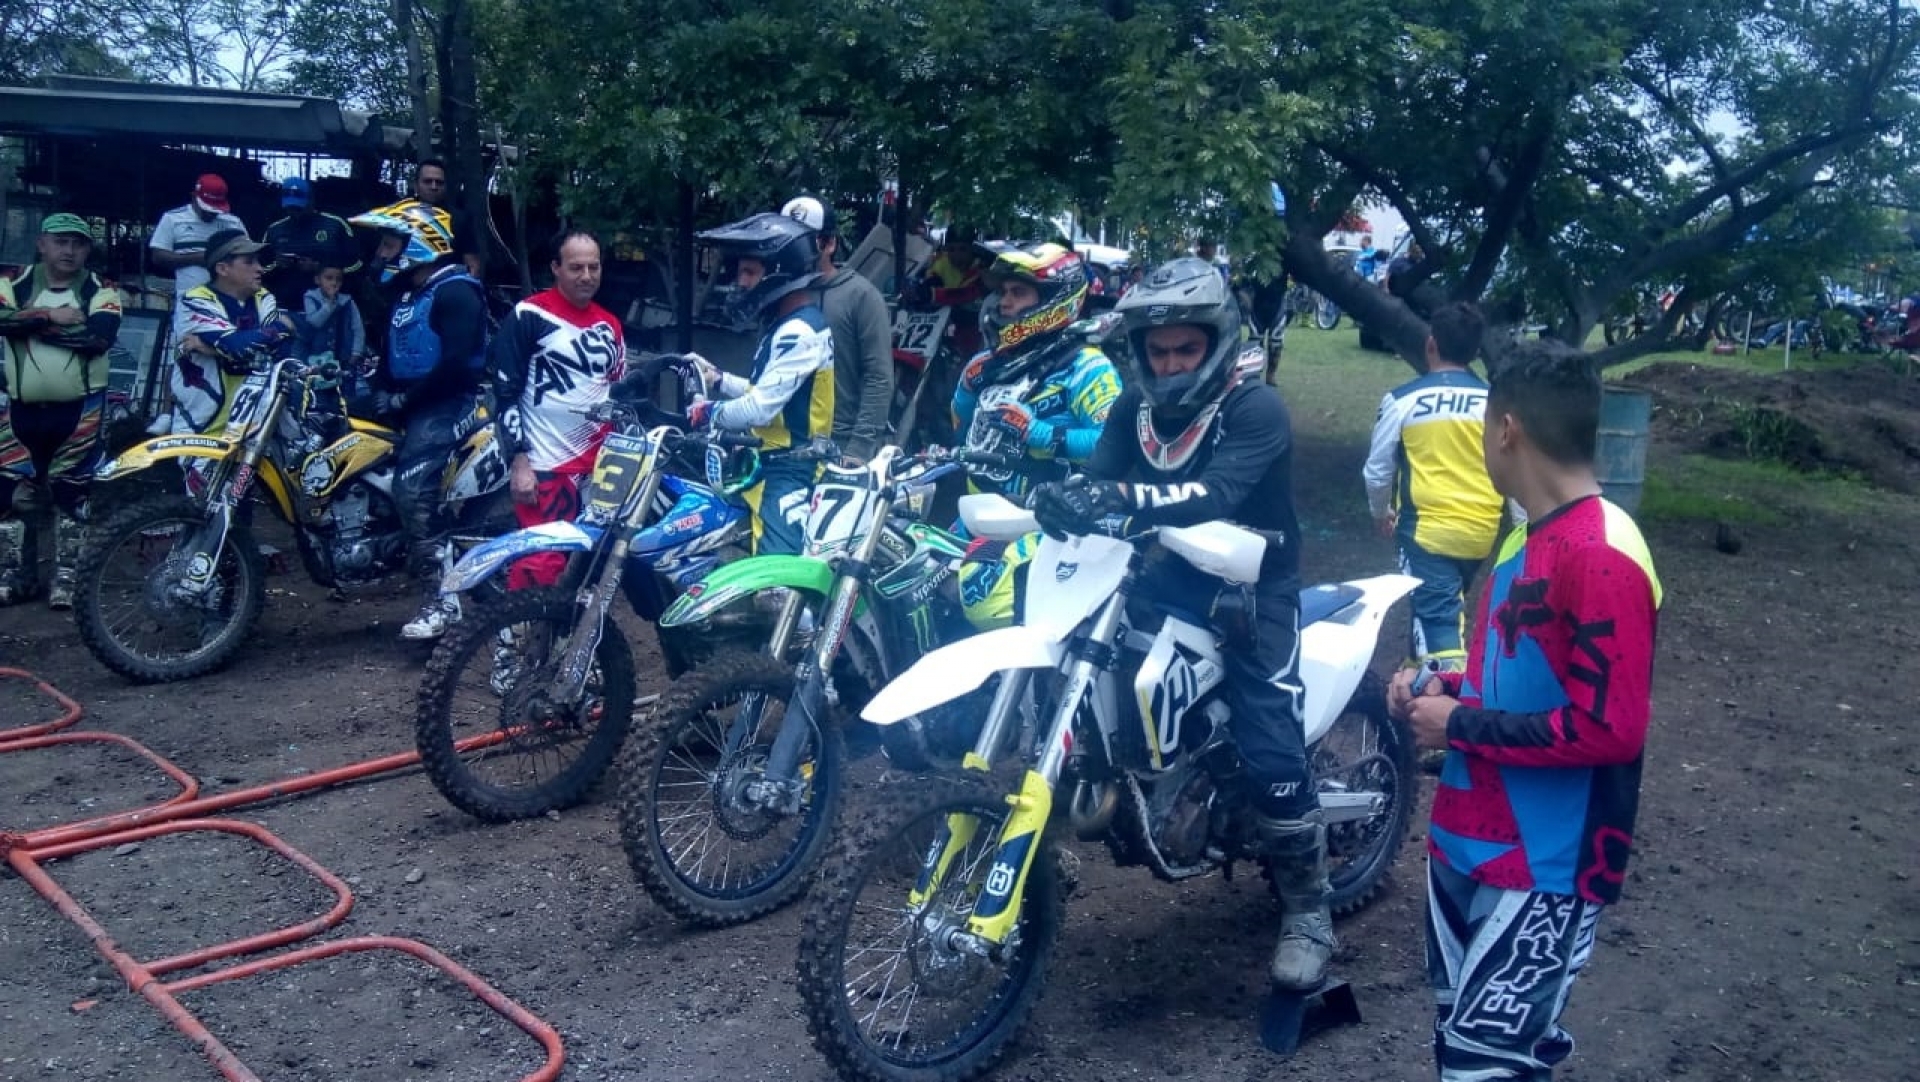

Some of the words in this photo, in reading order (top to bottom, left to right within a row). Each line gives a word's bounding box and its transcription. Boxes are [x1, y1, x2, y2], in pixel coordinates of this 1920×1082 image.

[900, 323, 934, 349] 12
[1412, 392, 1489, 418] SHIF
[590, 454, 640, 505] 3
[813, 488, 856, 541] 7
